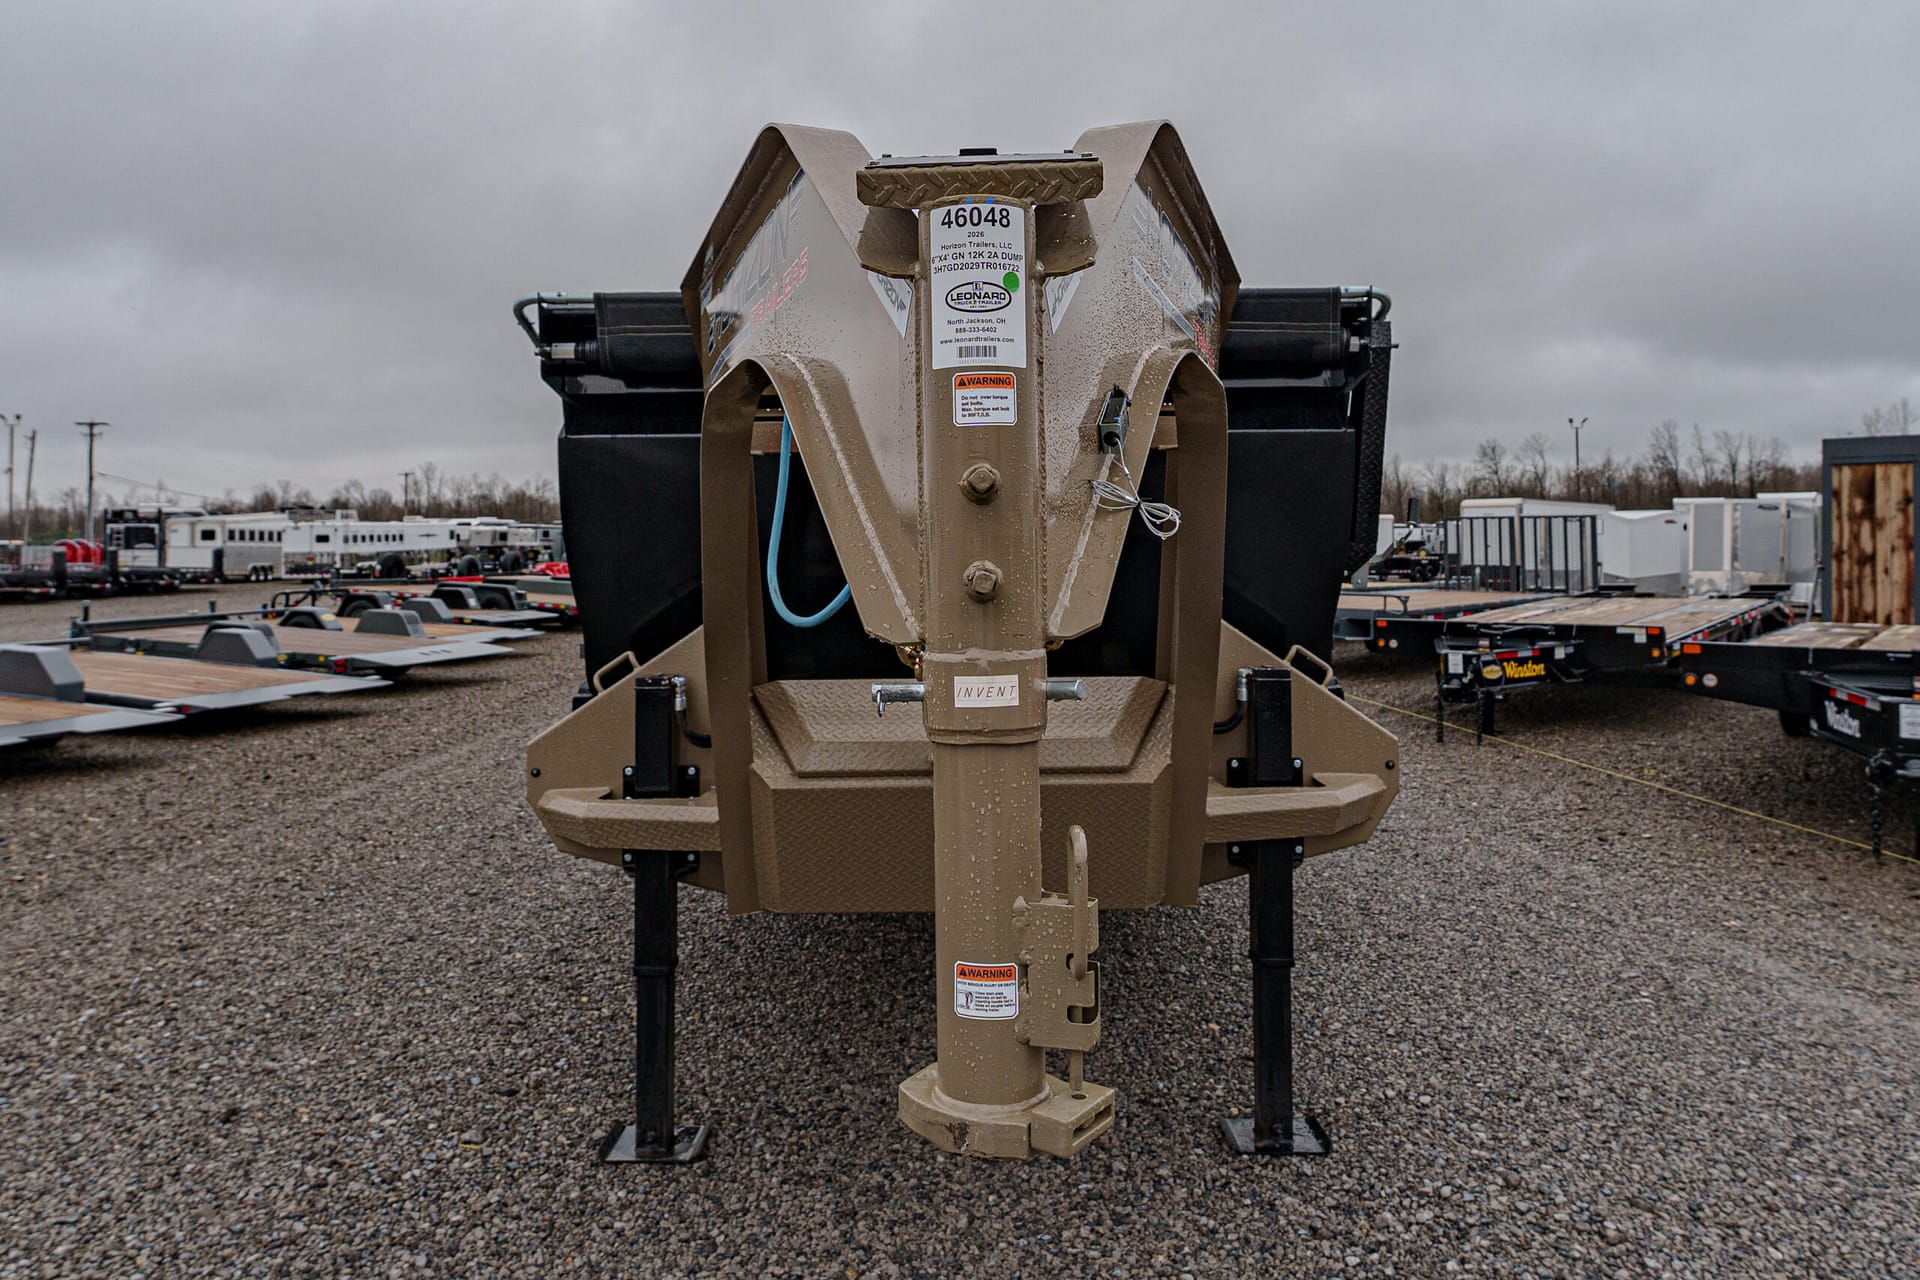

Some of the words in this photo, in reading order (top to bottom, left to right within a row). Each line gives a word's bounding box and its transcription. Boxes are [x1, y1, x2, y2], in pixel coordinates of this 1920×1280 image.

[941, 207, 1011, 229] 46048
[940, 243, 967, 251] Horizon
[968, 241, 998, 249] Trailers,
[999, 242, 1013, 250] LLC
[951, 252, 965, 261] GN
[987, 251, 999, 259] 2A
[1001, 251, 1024, 261] DUMP
[950, 292, 1006, 302] LEONARD
[996, 317, 1006, 325] OH
[955, 326, 997, 334] 888-333-6402
[940, 336, 1015, 345] www.leonardtrailers.com
[967, 376, 1011, 386] WARNING
[1502, 660, 1546, 679] Winston
[956, 685, 1017, 698] INVENT
[968, 968, 1013, 978] WARNING
